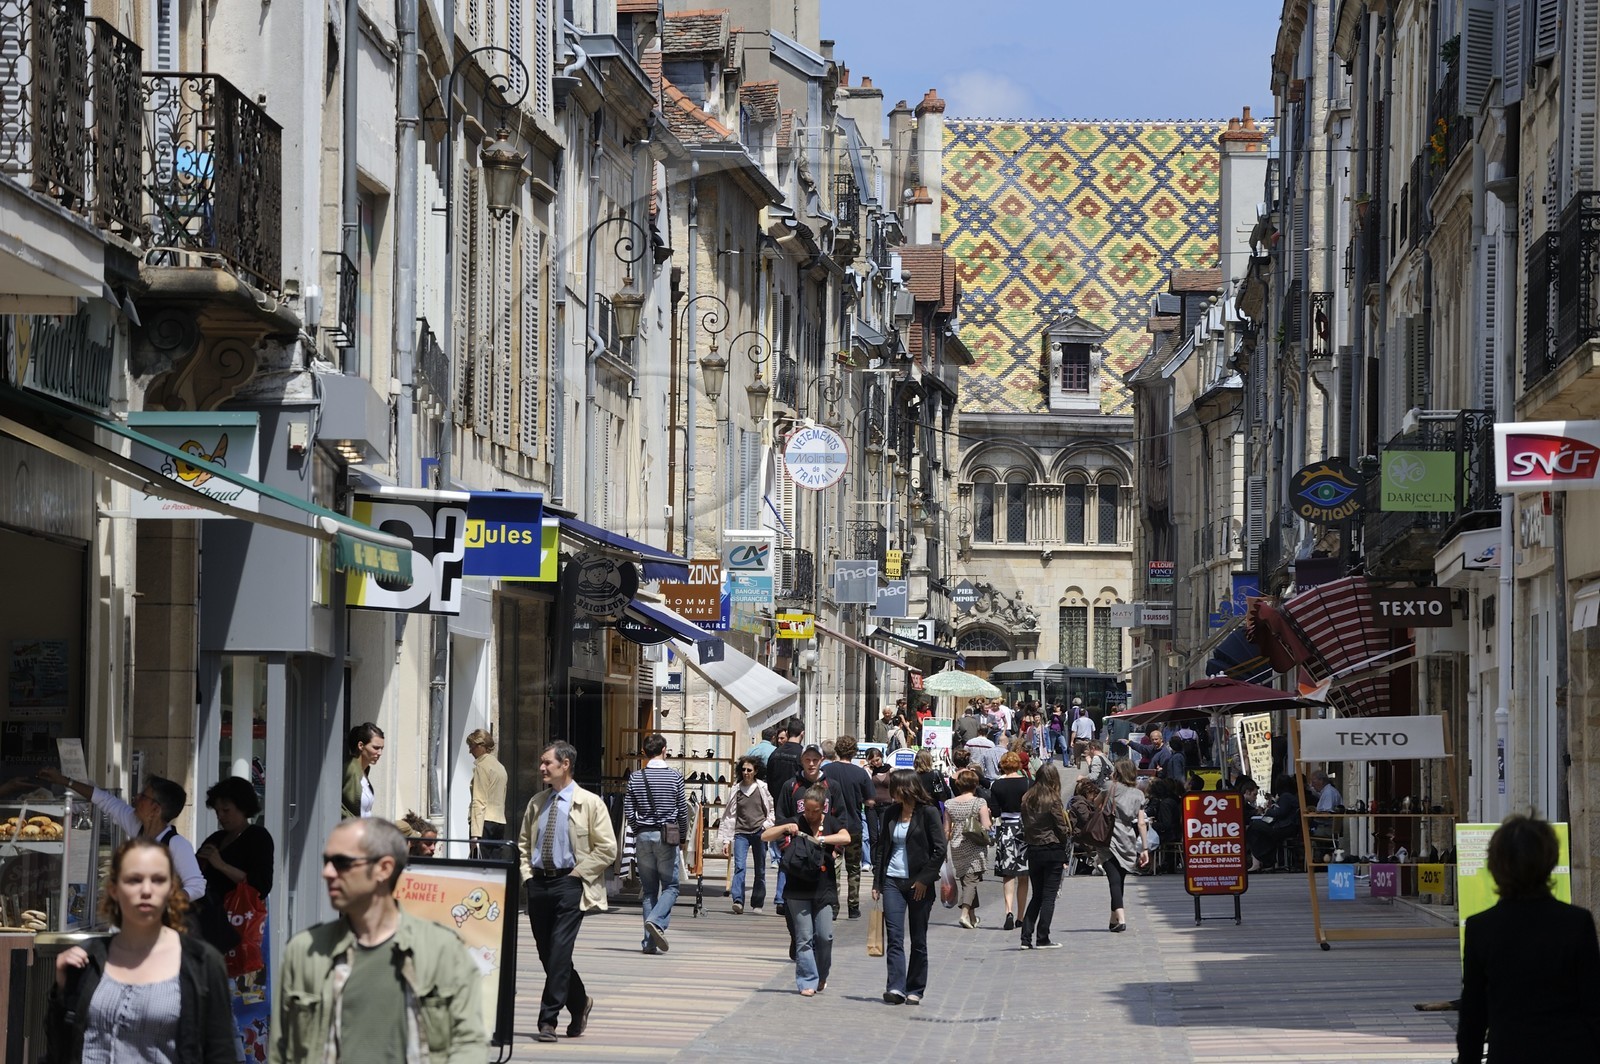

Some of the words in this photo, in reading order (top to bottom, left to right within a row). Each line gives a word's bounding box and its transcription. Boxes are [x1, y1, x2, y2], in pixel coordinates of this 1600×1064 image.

[792, 429, 839, 450] VETEMENTS
[1510, 446, 1595, 476] SNCF
[795, 467, 838, 484] TRAVAIL
[1301, 498, 1361, 521] OPTIQUE
[469, 524, 533, 544] Jules
[836, 566, 877, 582] fnac
[877, 585, 907, 598] nac
[1379, 600, 1443, 616] TEXTO
[1245, 720, 1268, 734] BIG
[1335, 732, 1409, 746] TEXTO
[1203, 795, 1229, 816] 2e
[1187, 818, 1240, 839] Paire
[1189, 841, 1242, 855] offerte
[440, 891, 446, 903] !
